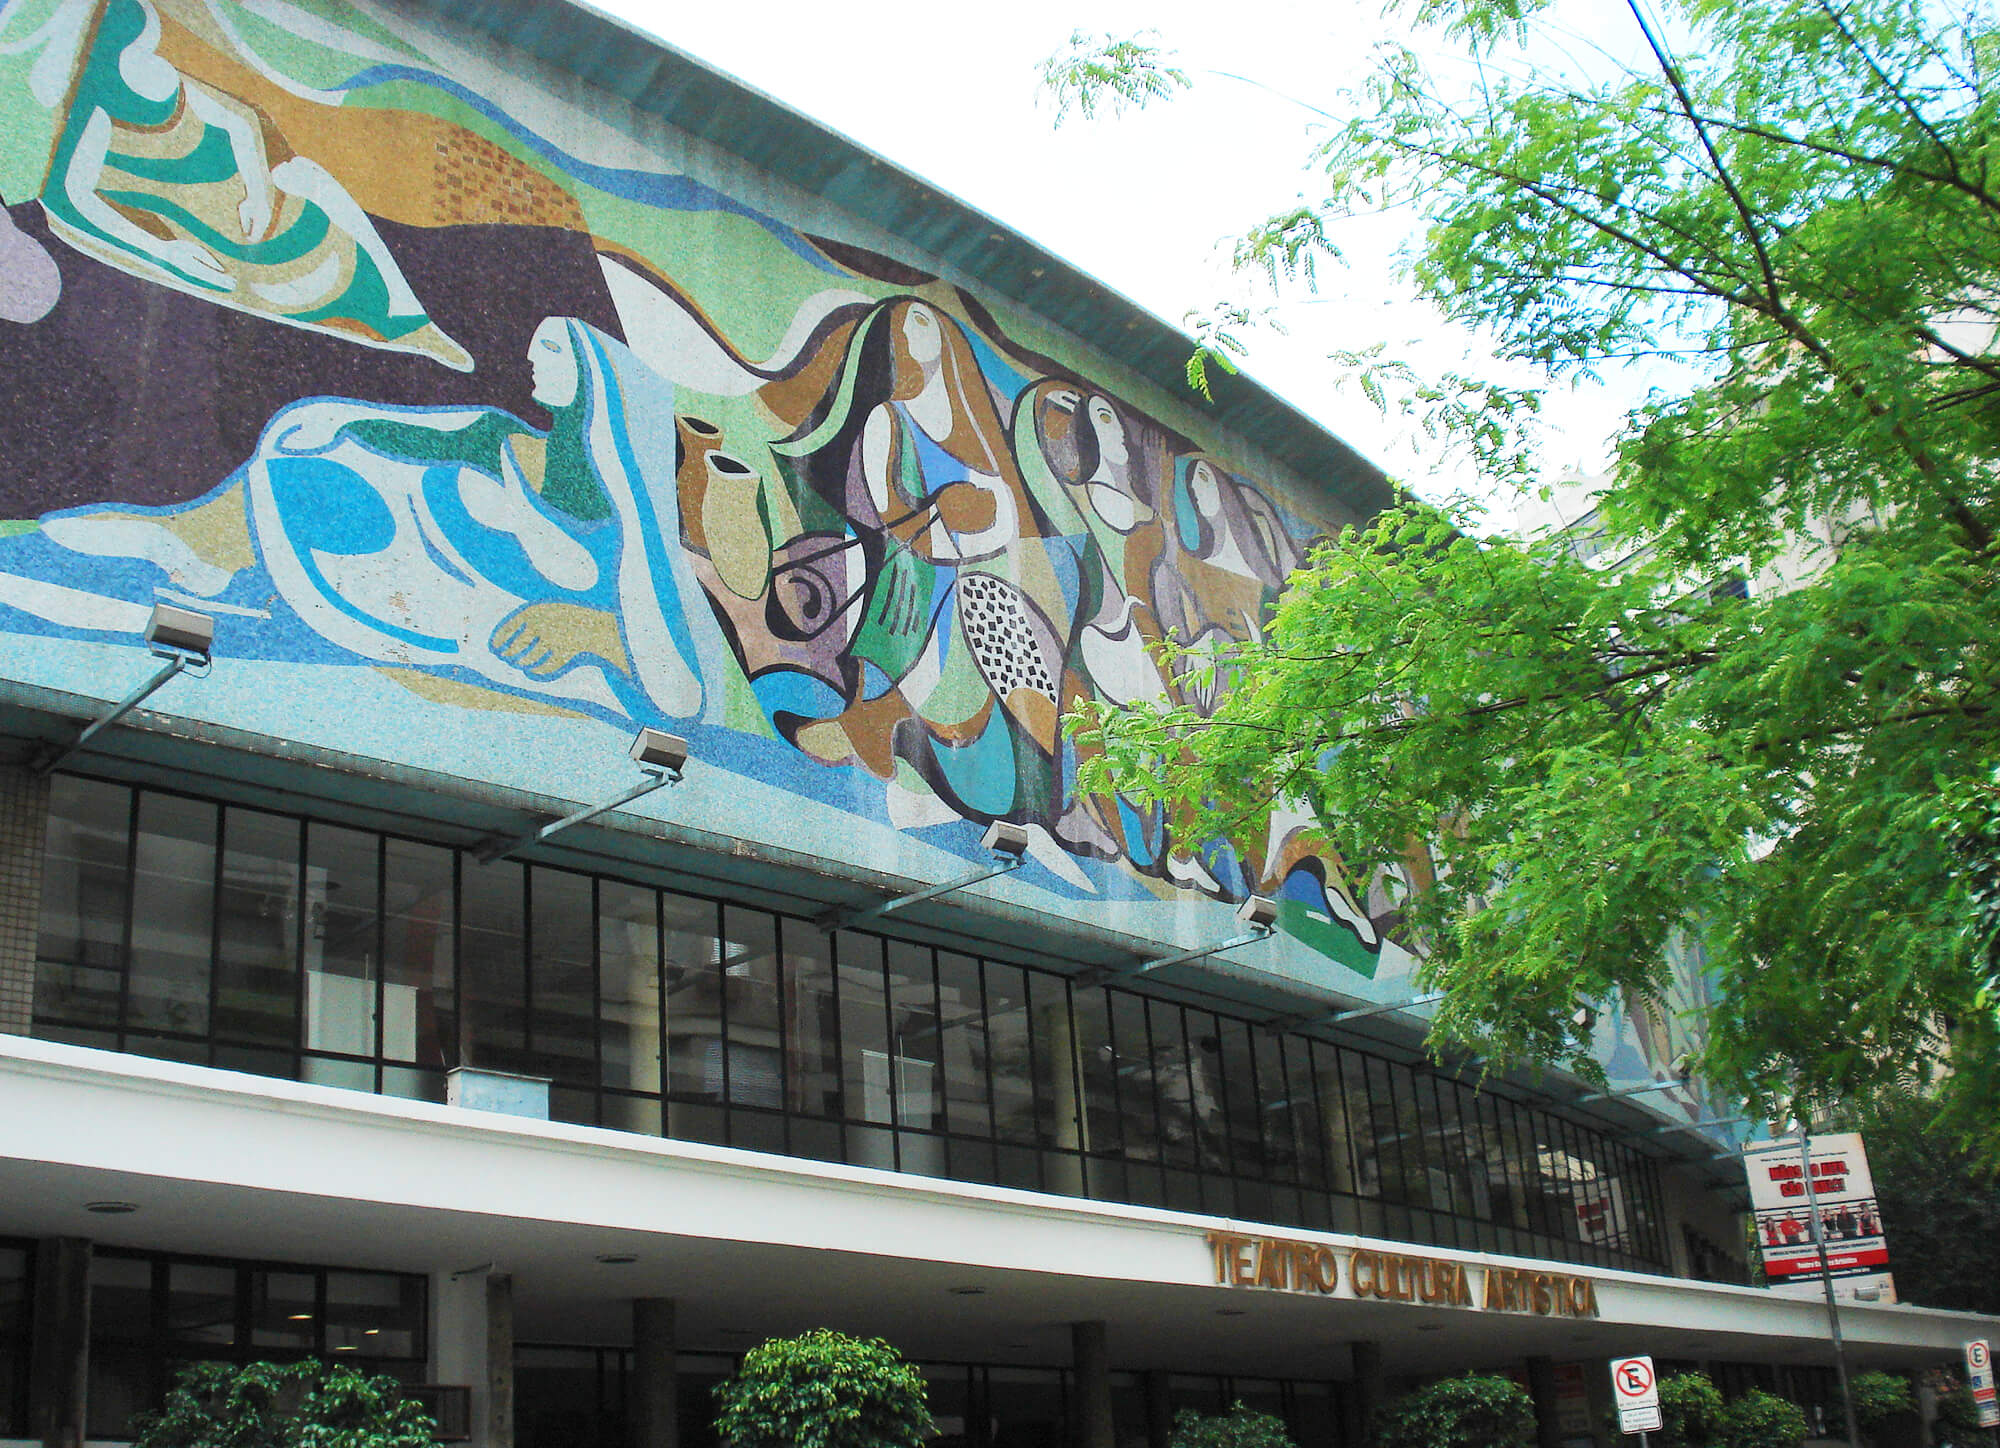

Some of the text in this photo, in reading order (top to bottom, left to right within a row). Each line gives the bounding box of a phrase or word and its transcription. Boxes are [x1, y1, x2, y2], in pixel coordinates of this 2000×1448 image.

[1208, 1232, 1600, 1318] TEATRO CULTURA ARTISTICA
[1974, 1347, 1982, 1363] E
[1626, 1367, 1641, 1389] E
